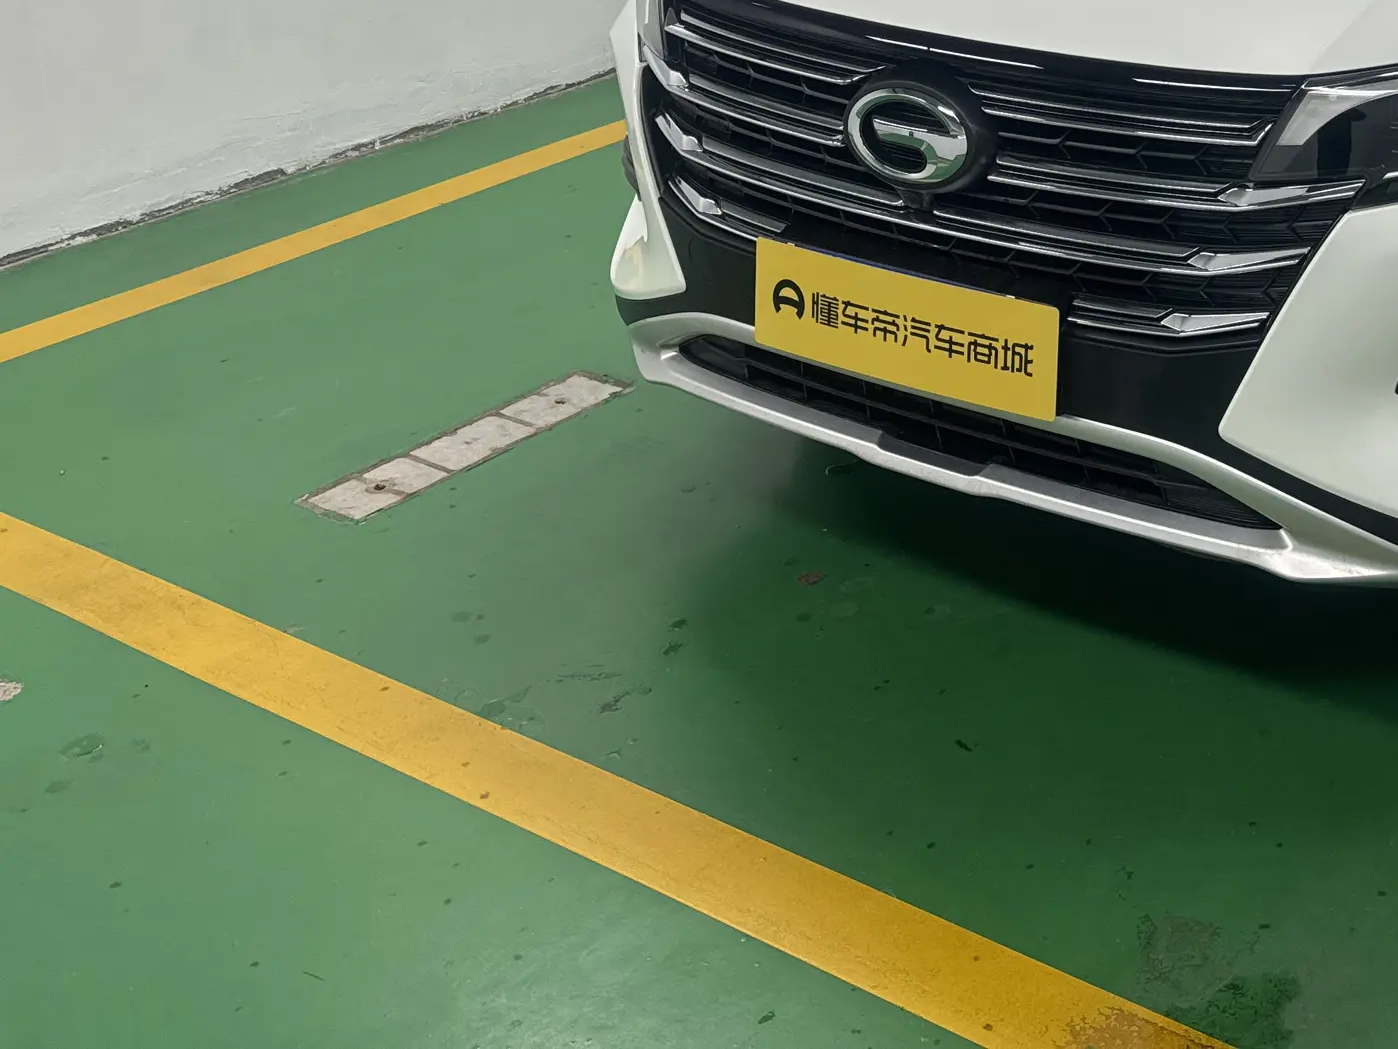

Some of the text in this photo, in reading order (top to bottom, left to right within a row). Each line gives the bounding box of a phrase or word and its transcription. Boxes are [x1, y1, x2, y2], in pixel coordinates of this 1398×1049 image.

[811, 291, 1034, 377] 懂车帝汽车商城
